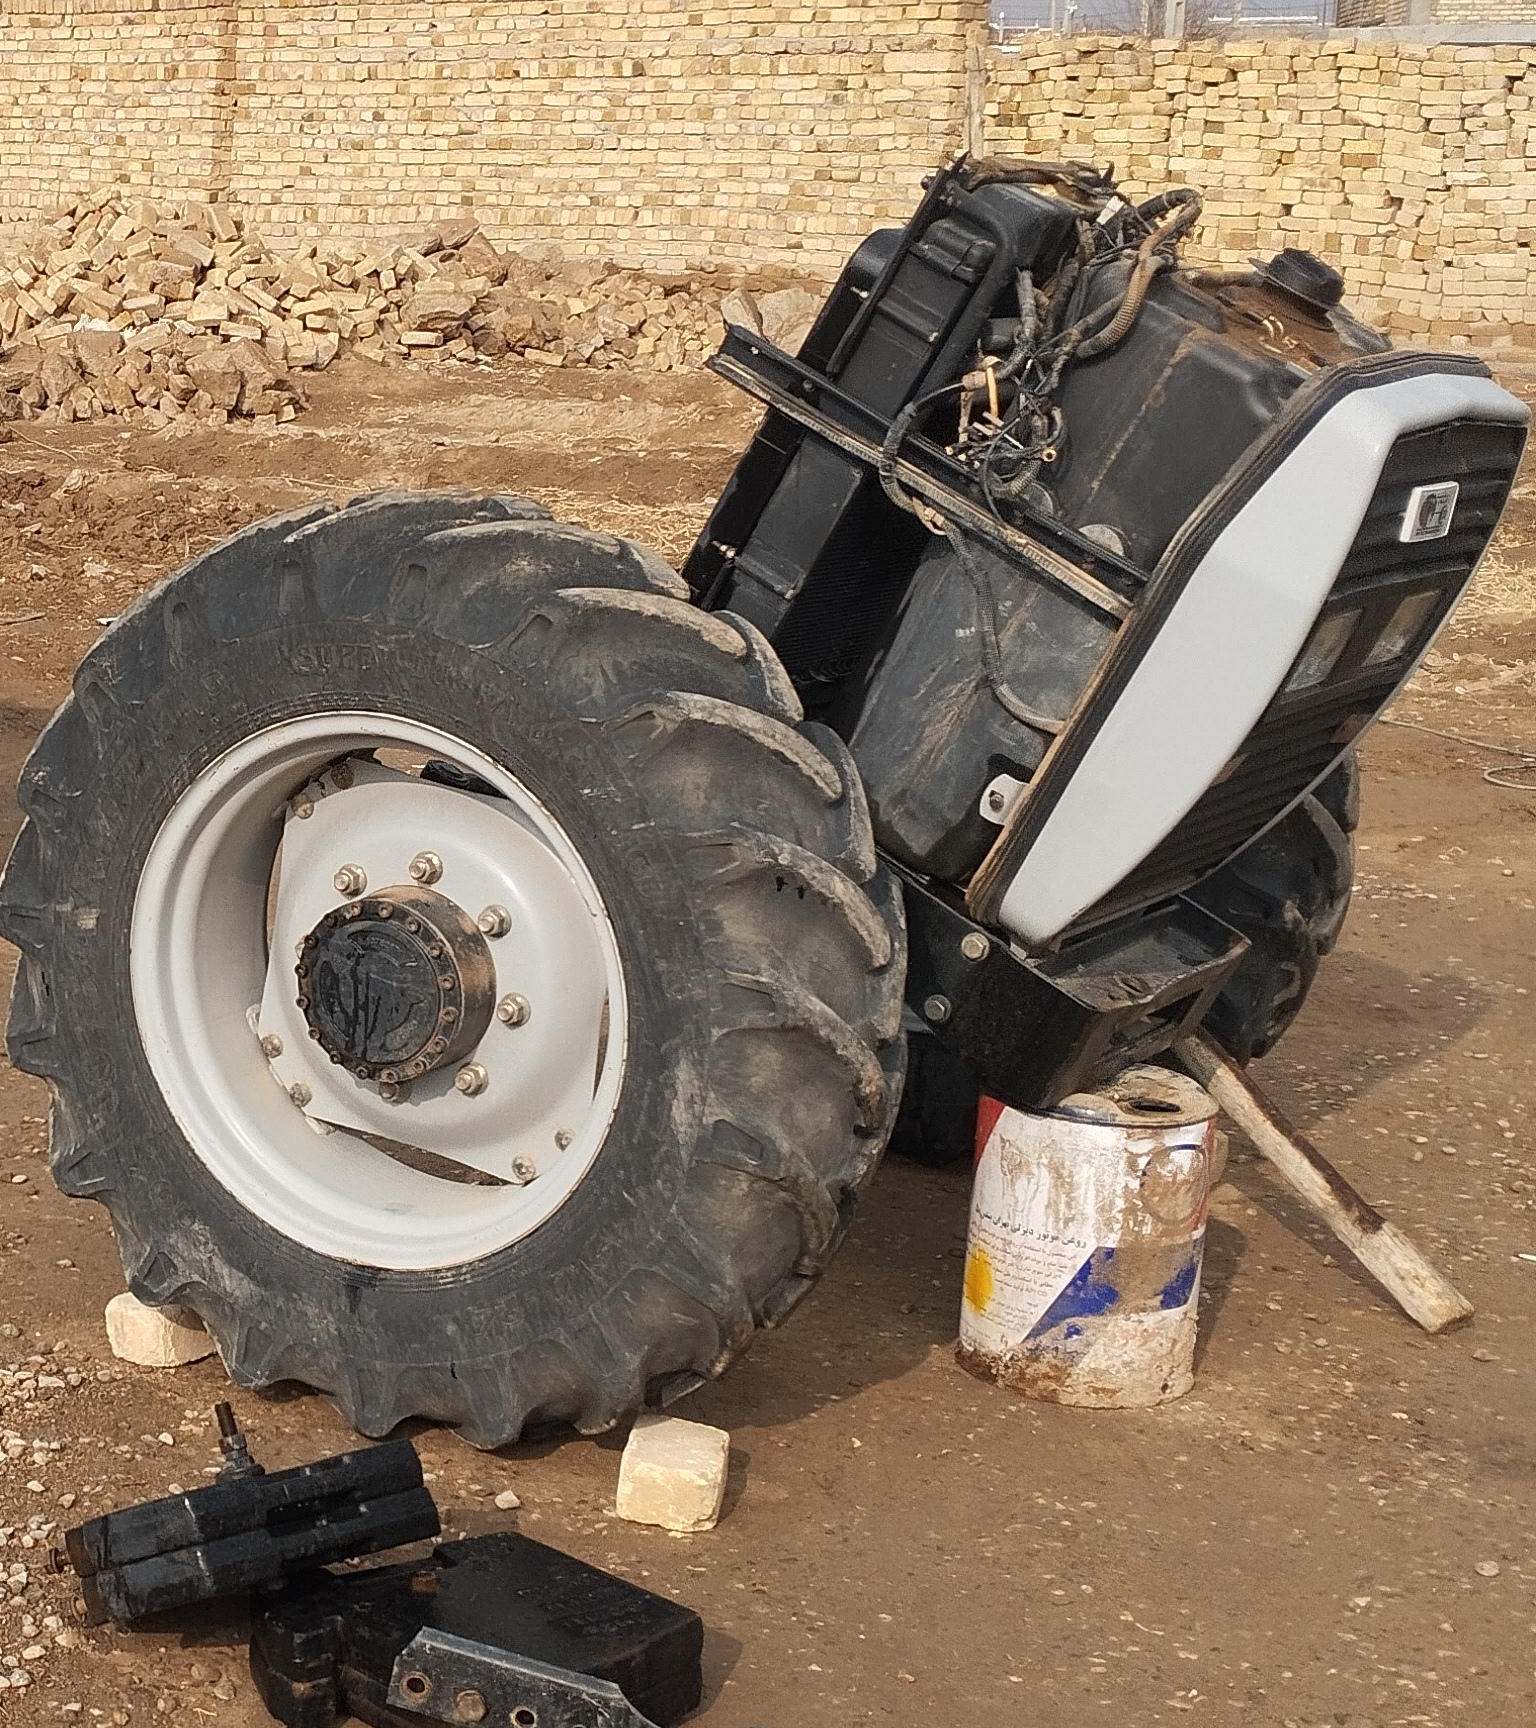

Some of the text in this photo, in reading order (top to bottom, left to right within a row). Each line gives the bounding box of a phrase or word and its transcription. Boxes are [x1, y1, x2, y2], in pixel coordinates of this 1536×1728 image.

[1011, 1223, 1035, 1237] دیزلی
[1036, 1230, 1060, 1243] موتور
[1062, 1237, 1088, 1249] روغن
